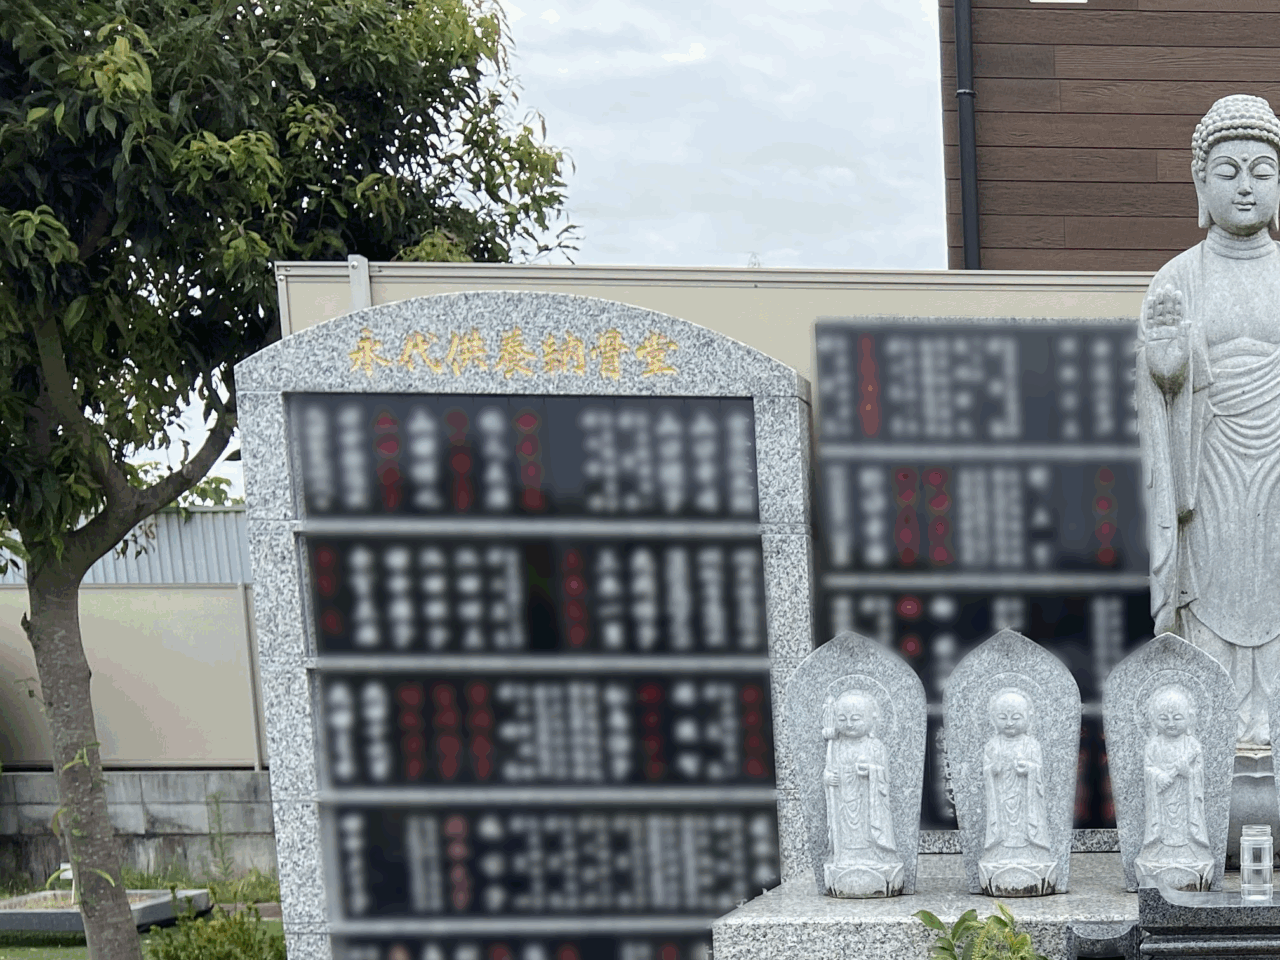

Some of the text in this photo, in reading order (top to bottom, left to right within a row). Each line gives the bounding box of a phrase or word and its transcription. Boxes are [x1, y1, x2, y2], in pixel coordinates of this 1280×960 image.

[350, 326, 678, 380] 永代供養納骨堂
